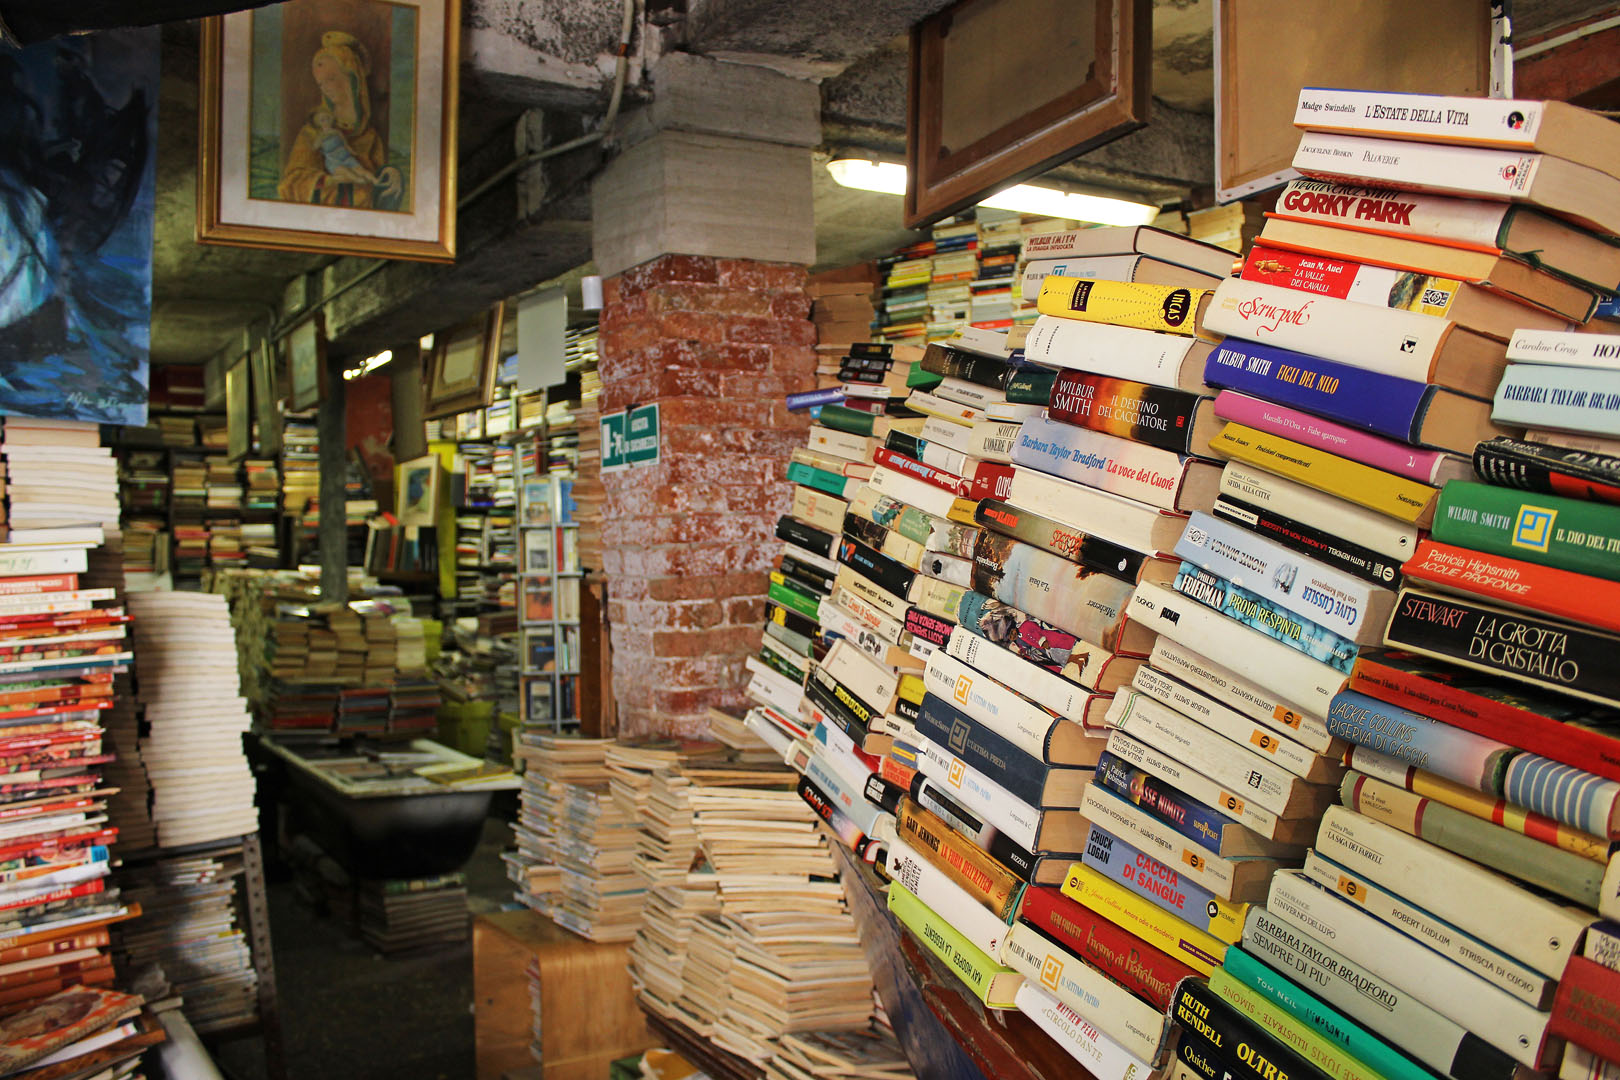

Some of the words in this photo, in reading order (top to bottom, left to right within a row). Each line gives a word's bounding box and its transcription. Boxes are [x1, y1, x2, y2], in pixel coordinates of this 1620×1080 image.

[1302, 102, 1322, 112] Madge
[1325, 103, 1356, 112] Swindells
[1365, 104, 1408, 120] L'ESTATE
[1409, 107, 1442, 123] DELLA
[1446, 109, 1469, 126] VITA
[1284, 191, 1356, 217] GORKY
[1355, 200, 1417, 226] PARK
[1051, 234, 1077, 245] SMITH
[1295, 269, 1302, 277] LA
[1304, 271, 1325, 281] VALLE
[1299, 259, 1315, 269] Jean
[1316, 262, 1324, 270] M.
[1326, 264, 1343, 274] Auel
[1290, 279, 1302, 288] DEI
[1304, 281, 1330, 292] CAVALLI
[1166, 293, 1186, 322] INCAS
[1515, 339, 1552, 353] Caroline
[1554, 343, 1578, 355] Gray
[1217, 348, 1246, 368] WILBUR
[1246, 357, 1273, 376] SMITH
[1059, 380, 1095, 399] WILBUR
[1276, 365, 1298, 383] FIGLI
[1298, 371, 1315, 388] DEL
[1316, 376, 1340, 395] NILO
[1053, 393, 1092, 416] SMITH
[1111, 395, 1119, 406] IL
[1121, 397, 1159, 414] DESTINO
[1504, 384, 1548, 403] BARBARA
[1551, 387, 1588, 407] TAYLOR
[1098, 406, 1113, 418] DEL
[1114, 409, 1168, 431] CACCIATORE
[1022, 435, 1049, 452] Barbara
[1049, 443, 1072, 461] Taylor
[1072, 449, 1106, 470] Bradford
[1106, 460, 1119, 474] La
[1118, 466, 1136, 479] voce
[1136, 469, 1150, 483] del
[1150, 471, 1175, 491] Cuore
[1395, 493, 1424, 508] Sonzogno
[1447, 505, 1478, 524] WILBUR
[1479, 512, 1511, 530] SMITH
[1556, 528, 1565, 541] IL
[1567, 530, 1586, 546] DIO
[1586, 534, 1605, 550] DEL
[1328, 546, 1351, 561] RENDELL
[1350, 556, 1365, 567] RUTH
[1427, 549, 1467, 568] Patricia
[1467, 559, 1520, 581] Highsmith
[1197, 571, 1216, 586] PHILIP
[1417, 562, 1462, 578] ACQUE
[1461, 570, 1532, 595] PROFONDE
[1179, 574, 1224, 609] FRIEDMAN
[1302, 585, 1335, 614] CUSSLER
[1087, 600, 1116, 618] Michener
[1229, 593, 1257, 618] PROVA
[1256, 605, 1303, 641] RESPINTA
[1334, 601, 1358, 625] CLIVE
[1402, 598, 1468, 629] STEWART
[1475, 616, 1497, 638] LA
[1499, 620, 1568, 655] GROTTA
[1468, 637, 1488, 659] DI
[1489, 642, 1579, 683] CRISTALLO
[1137, 679, 1154, 691] ROTTA
[1231, 685, 1253, 700] KRANTZ
[1174, 692, 1191, 706] SMITH
[1191, 699, 1211, 716] WILBUR
[1251, 695, 1275, 712] JUDITH
[1330, 700, 1368, 728] JACKIE
[1368, 711, 1418, 742] COLLINS
[1112, 743, 1128, 755] ROTTA
[1329, 718, 1372, 746] RISERVA
[1374, 732, 1390, 750] DI
[1389, 739, 1430, 770] CACCIA
[1110, 765, 1127, 780] Patrick
[1145, 757, 1162, 769] SMITH
[1162, 764, 1181, 778] WILBUR
[1106, 771, 1128, 789] Robinson
[1130, 778, 1157, 804] CLASSE
[1157, 794, 1187, 825] NIMITZ
[906, 816, 918, 835] GARY
[918, 825, 940, 852] JENNINGS
[1090, 830, 1114, 851] CHUCK
[1335, 834, 1351, 848] SAGA
[941, 845, 948, 858] LA
[1087, 843, 1110, 864] LOGAN
[1136, 853, 1179, 888] CACCIA
[1122, 864, 1136, 880] DI
[1137, 873, 1186, 909] SANGUE
[1219, 911, 1236, 924] PIEMME
[1391, 908, 1419, 930] ROBERT
[1420, 924, 1451, 947] LUDLUM
[943, 945, 953, 957] LA
[1009, 940, 1025, 957] WILBUR
[1025, 951, 1041, 970] SMITH
[1252, 932, 1295, 966] SEMPRE
[1294, 958, 1308, 974] DI
[1308, 967, 1331, 987] PIU'
[1256, 916, 1301, 951] BARBARA
[1298, 941, 1337, 972] TAYLOR
[1337, 962, 1398, 1008] BRADFORD
[970, 969, 983, 984] KAY
[1459, 946, 1494, 971] STRISCIA
[1494, 964, 1505, 976] DI
[1506, 970, 1534, 994] CUOIO
[1223, 985, 1255, 1015] SIMONE
[1257, 976, 1273, 993] TOM
[1278, 991, 1297, 1009] NEIL
[1182, 992, 1210, 1020] RUTH
[1056, 1002, 1080, 1027] MATTHEW
[1080, 1020, 1100, 1043] PEARL
[1177, 1005, 1223, 1048] RENDELL
[1263, 1014, 1308, 1050] ILLUSTRATE
[1046, 1009, 1076, 1038] CIRCOLO
[1075, 1034, 1104, 1063] DANTE
[1184, 1045, 1216, 1078] Quicher
[1312, 1046, 1341, 1074] JURIS
